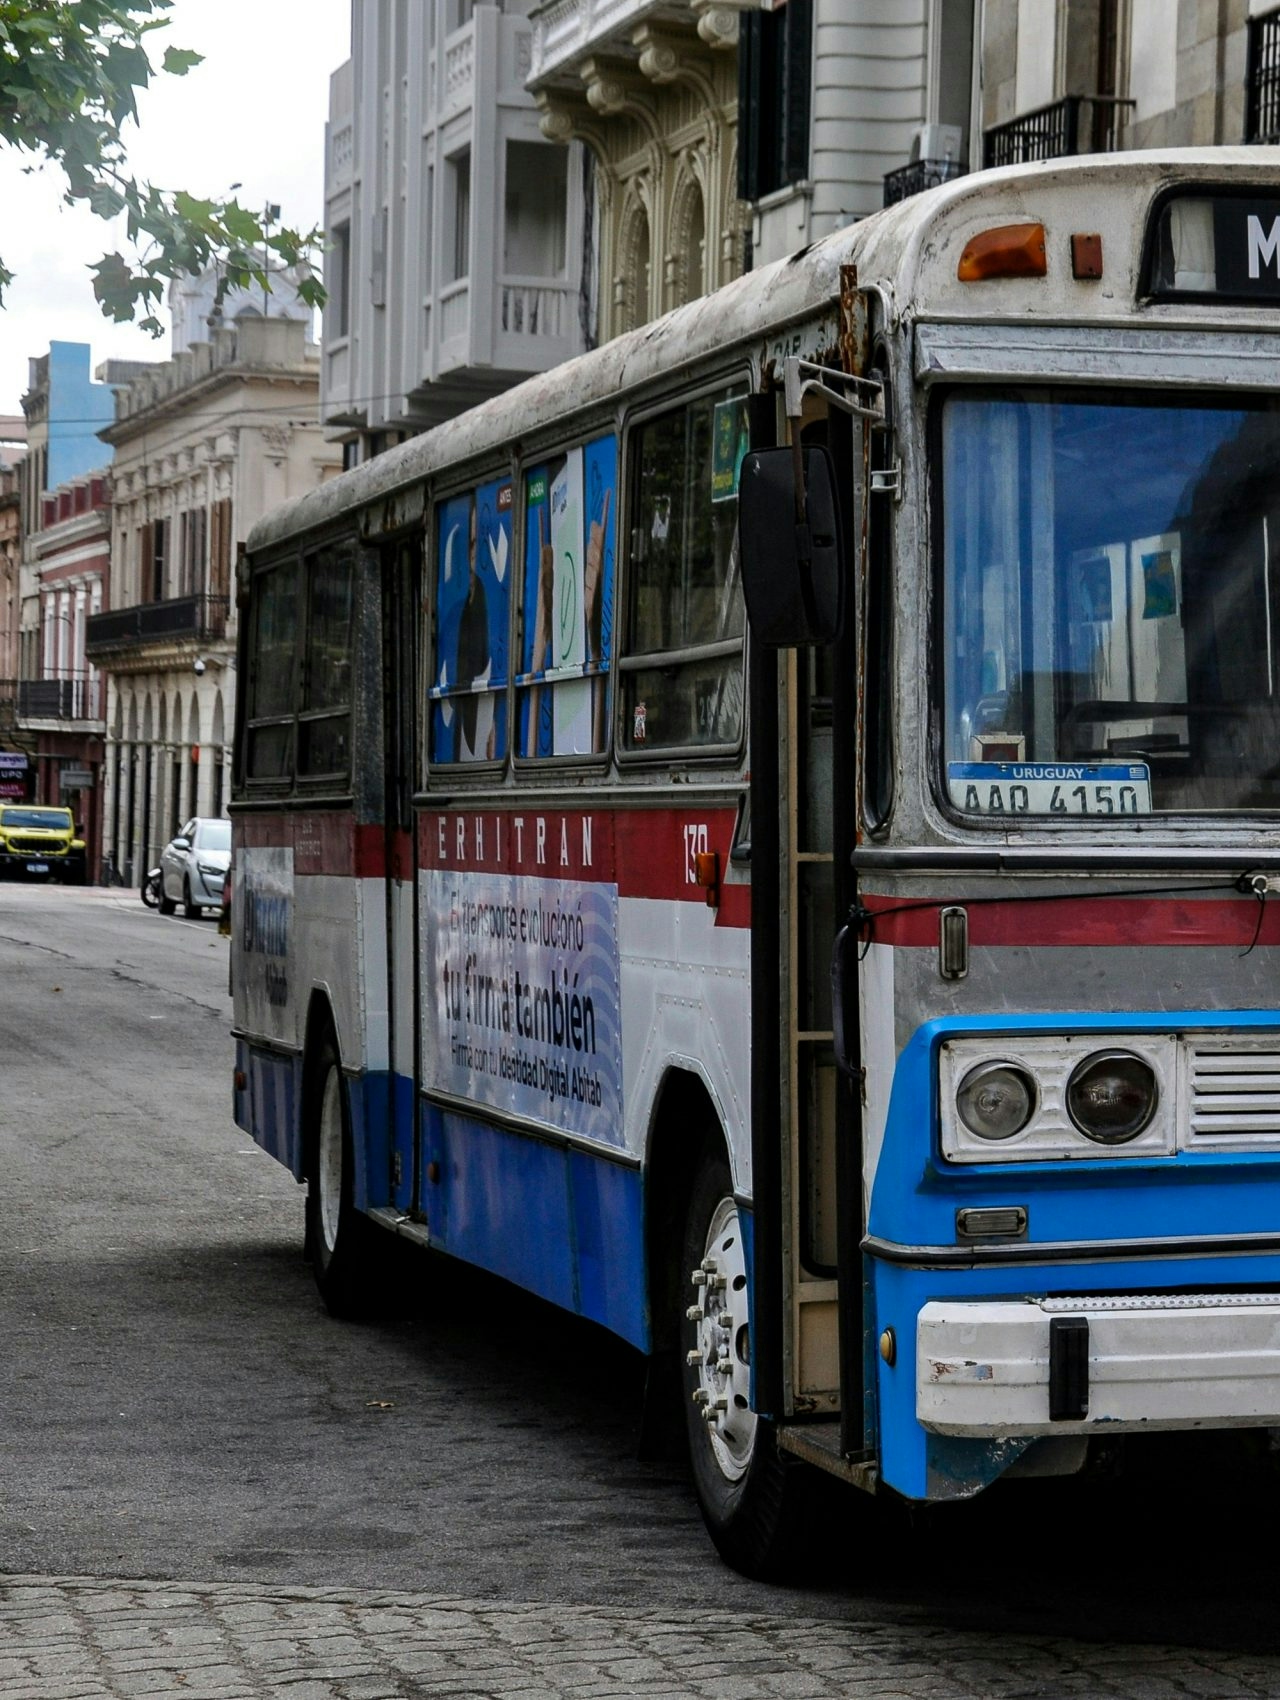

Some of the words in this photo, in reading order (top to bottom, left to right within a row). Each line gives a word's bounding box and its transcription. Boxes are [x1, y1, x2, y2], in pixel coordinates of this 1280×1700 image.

[529, 480, 545, 499] AHORA
[964, 784, 1030, 813] AAQ
[1049, 785, 1138, 814] 4150
[1012, 767, 1085, 780] URUGUAY
[438, 815, 593, 867] ERHITRAN
[450, 891, 458, 930] El
[461, 896, 517, 944] transporte
[519, 896, 584, 953] evolucionó
[442, 959, 461, 1022] tu
[464, 953, 511, 1034] firma
[514, 967, 597, 1055] también
[451, 1035, 473, 1069] Firma
[474, 1046, 489, 1073] con
[489, 1048, 498, 1077] tu
[498, 1047, 538, 1089] Identidad
[539, 1058, 569, 1104] Digital
[571, 1065, 602, 1109] Abitab
